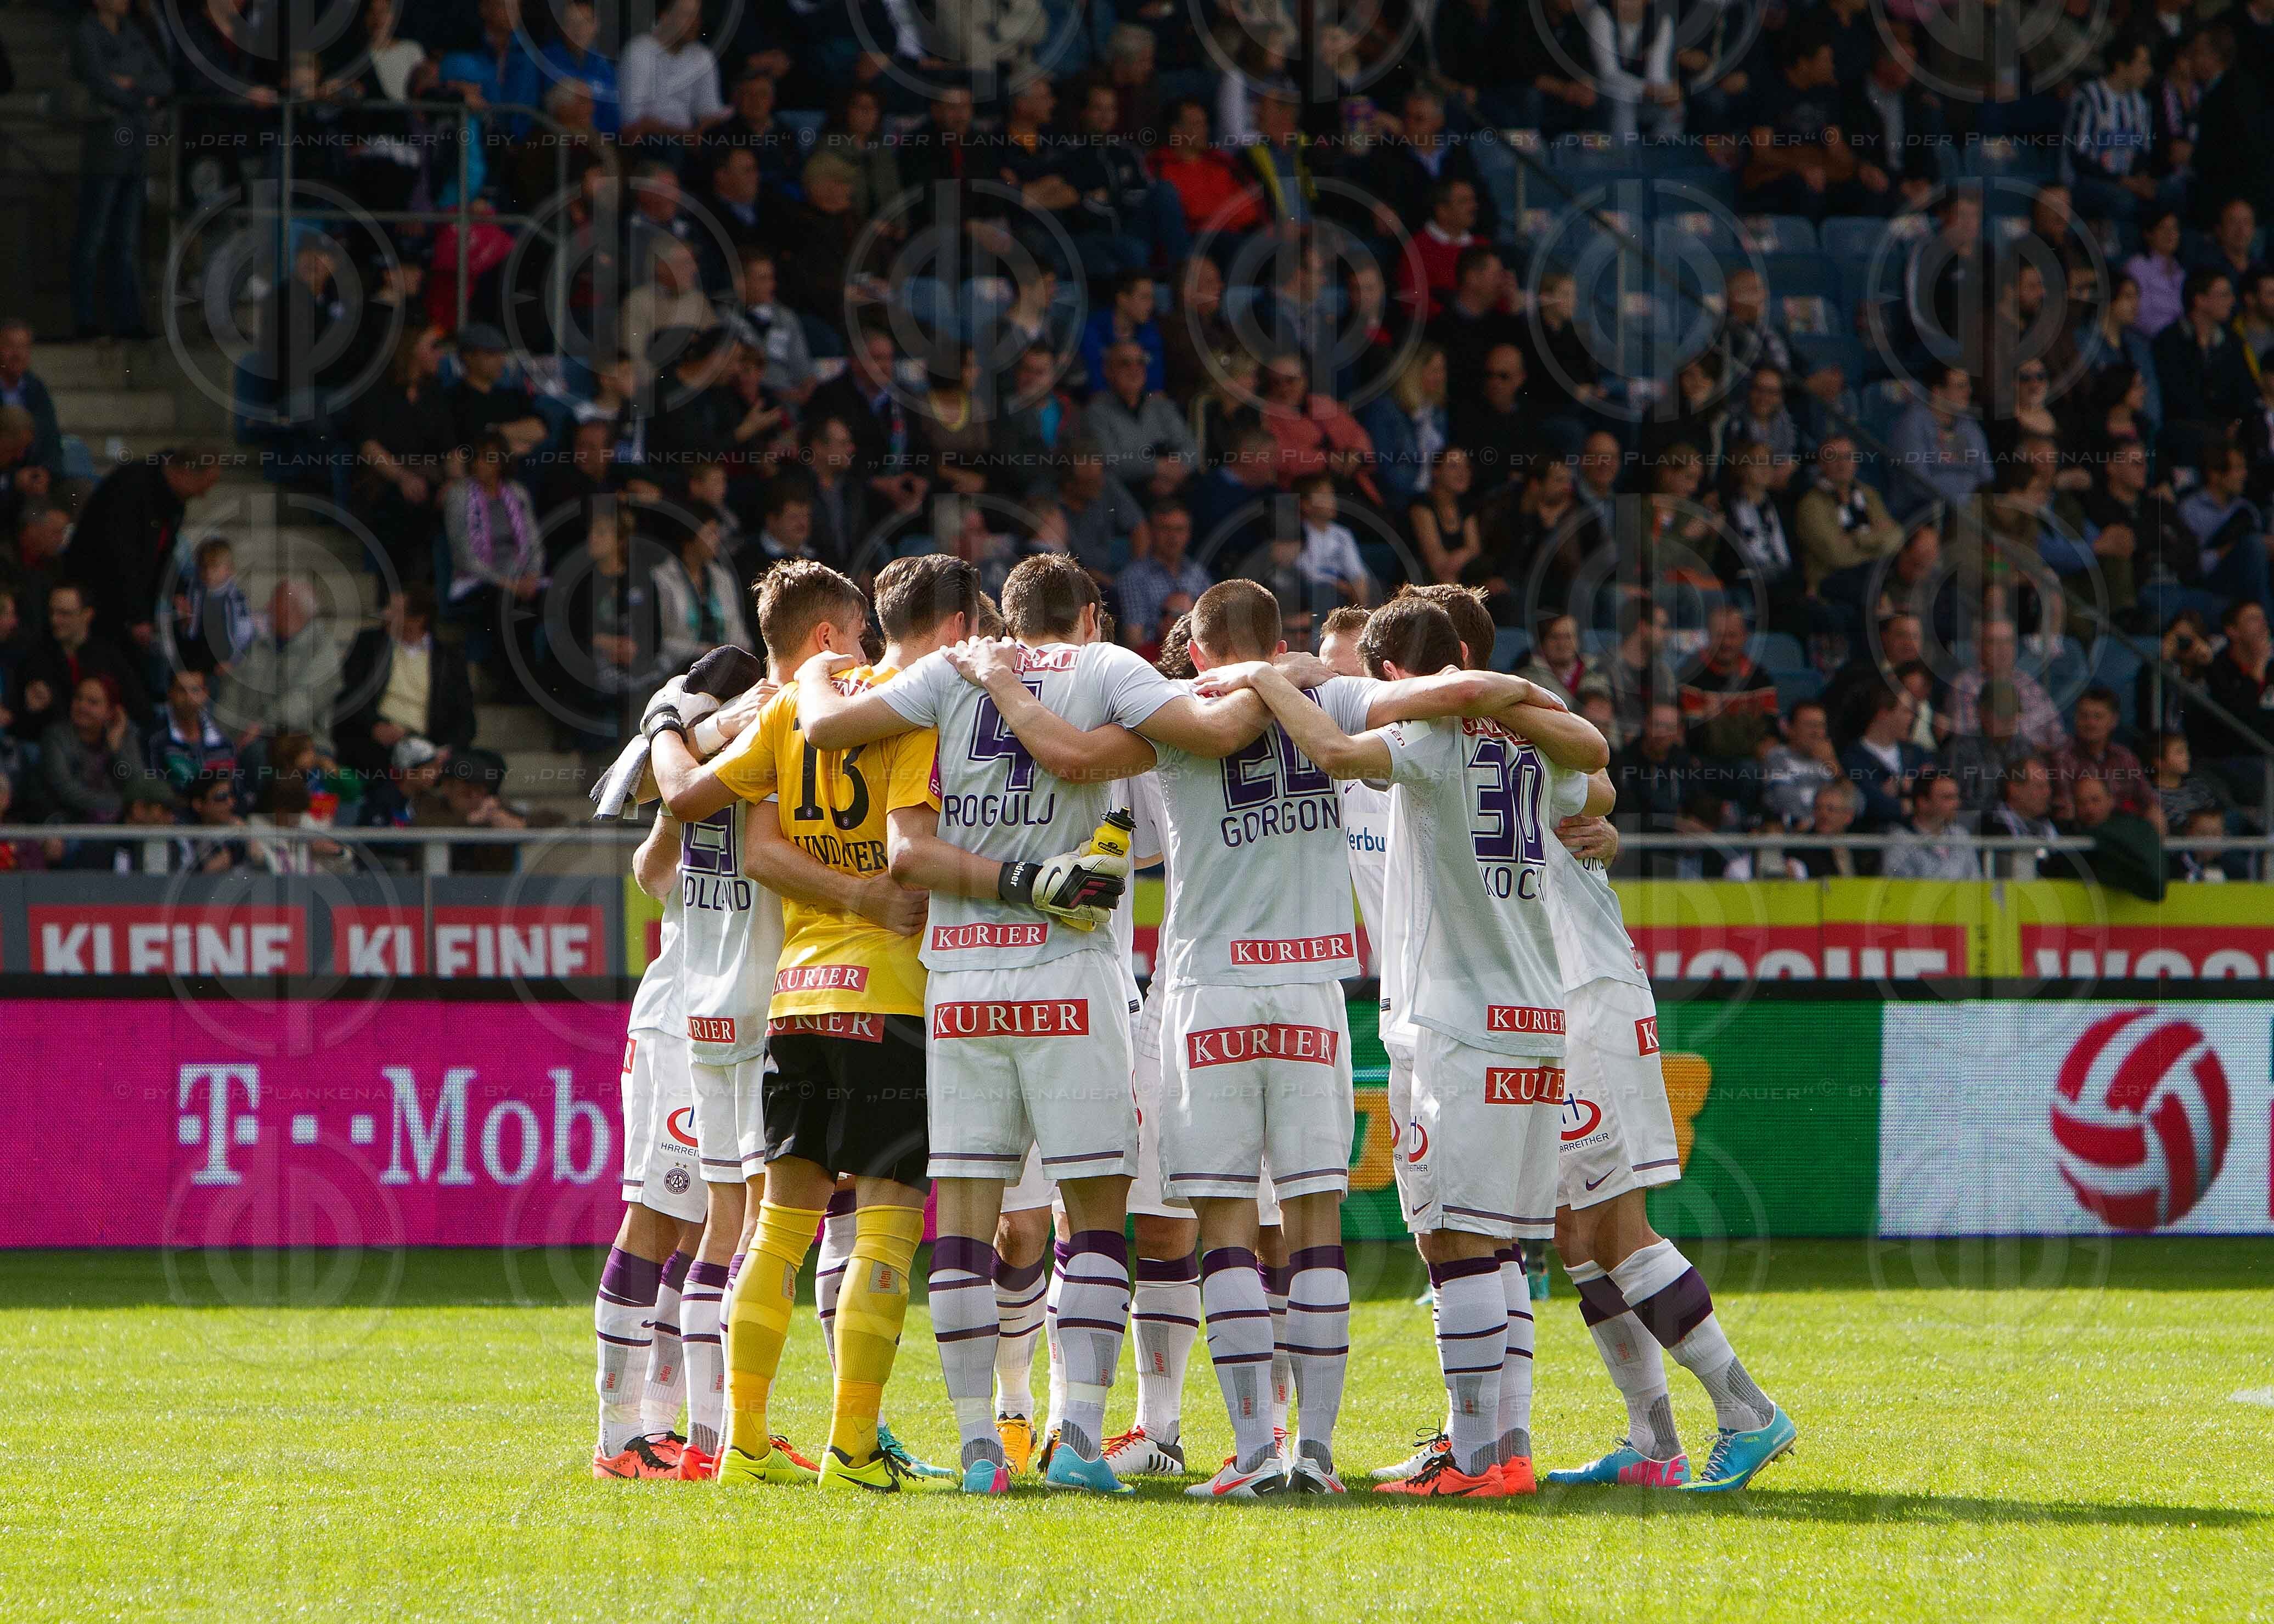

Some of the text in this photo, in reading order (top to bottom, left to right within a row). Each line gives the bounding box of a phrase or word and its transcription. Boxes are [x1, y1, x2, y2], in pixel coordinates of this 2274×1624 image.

[793, 718, 869, 831] 13
[944, 793, 1056, 828] ROGULJ
[1467, 739, 1546, 866] 30
[1220, 797, 1340, 848] GORGON
[1346, 826, 1387, 853] erbu
[936, 926, 1042, 948] KURIER
[1235, 936, 1348, 962] KURIER
[775, 967, 860, 992] KURIER
[935, 1003, 1078, 1034] KURIER
[1493, 1008, 1566, 1032] KURIER
[1192, 1027, 1334, 1064] KURIER
[1492, 1070, 1564, 1100] KUIE
[1409, 1164, 1428, 1172] EITHER
[1618, 1454, 1687, 1488] NIKE
